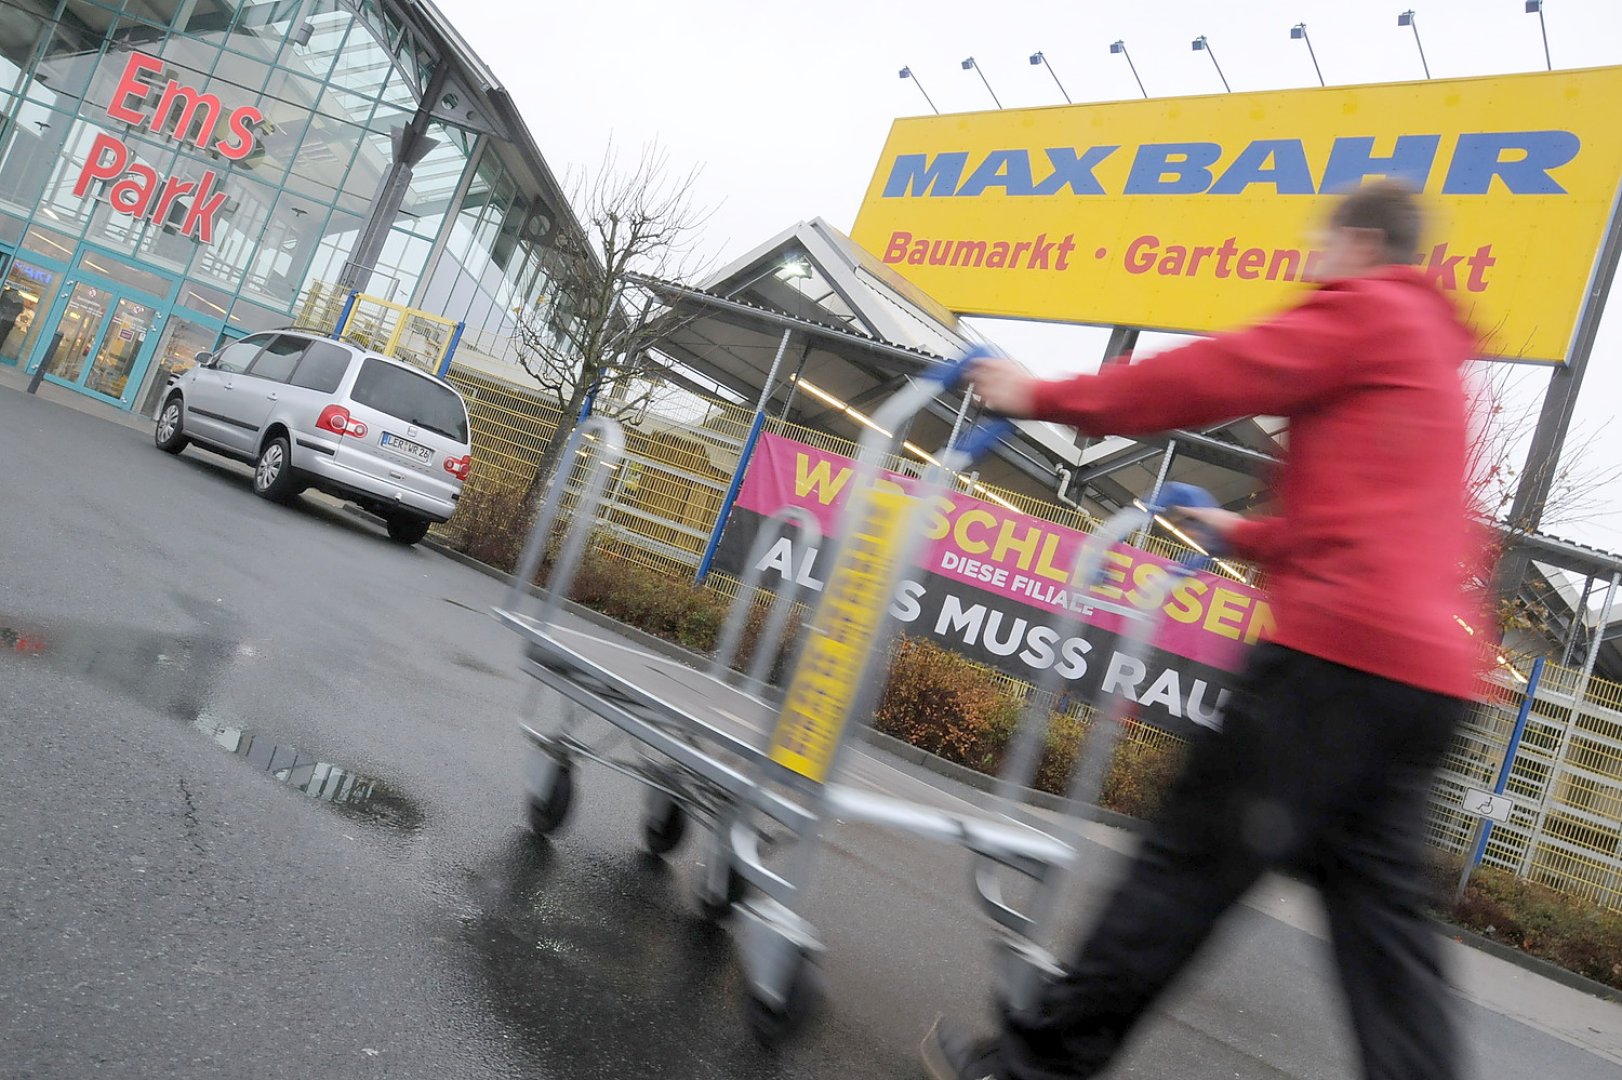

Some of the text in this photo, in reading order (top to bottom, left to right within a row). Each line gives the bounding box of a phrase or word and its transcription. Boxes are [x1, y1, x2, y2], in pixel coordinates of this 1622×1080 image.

[106, 51, 263, 160] Ems
[73, 132, 228, 244] Park
[881, 130, 1581, 198] MAX BAHR
[882, 231, 1496, 293] Baumarkt Gartenkt
[755, 536, 927, 622] ALS
[934, 594, 1093, 680] MUSS
[941, 551, 1009, 588] DIESE
